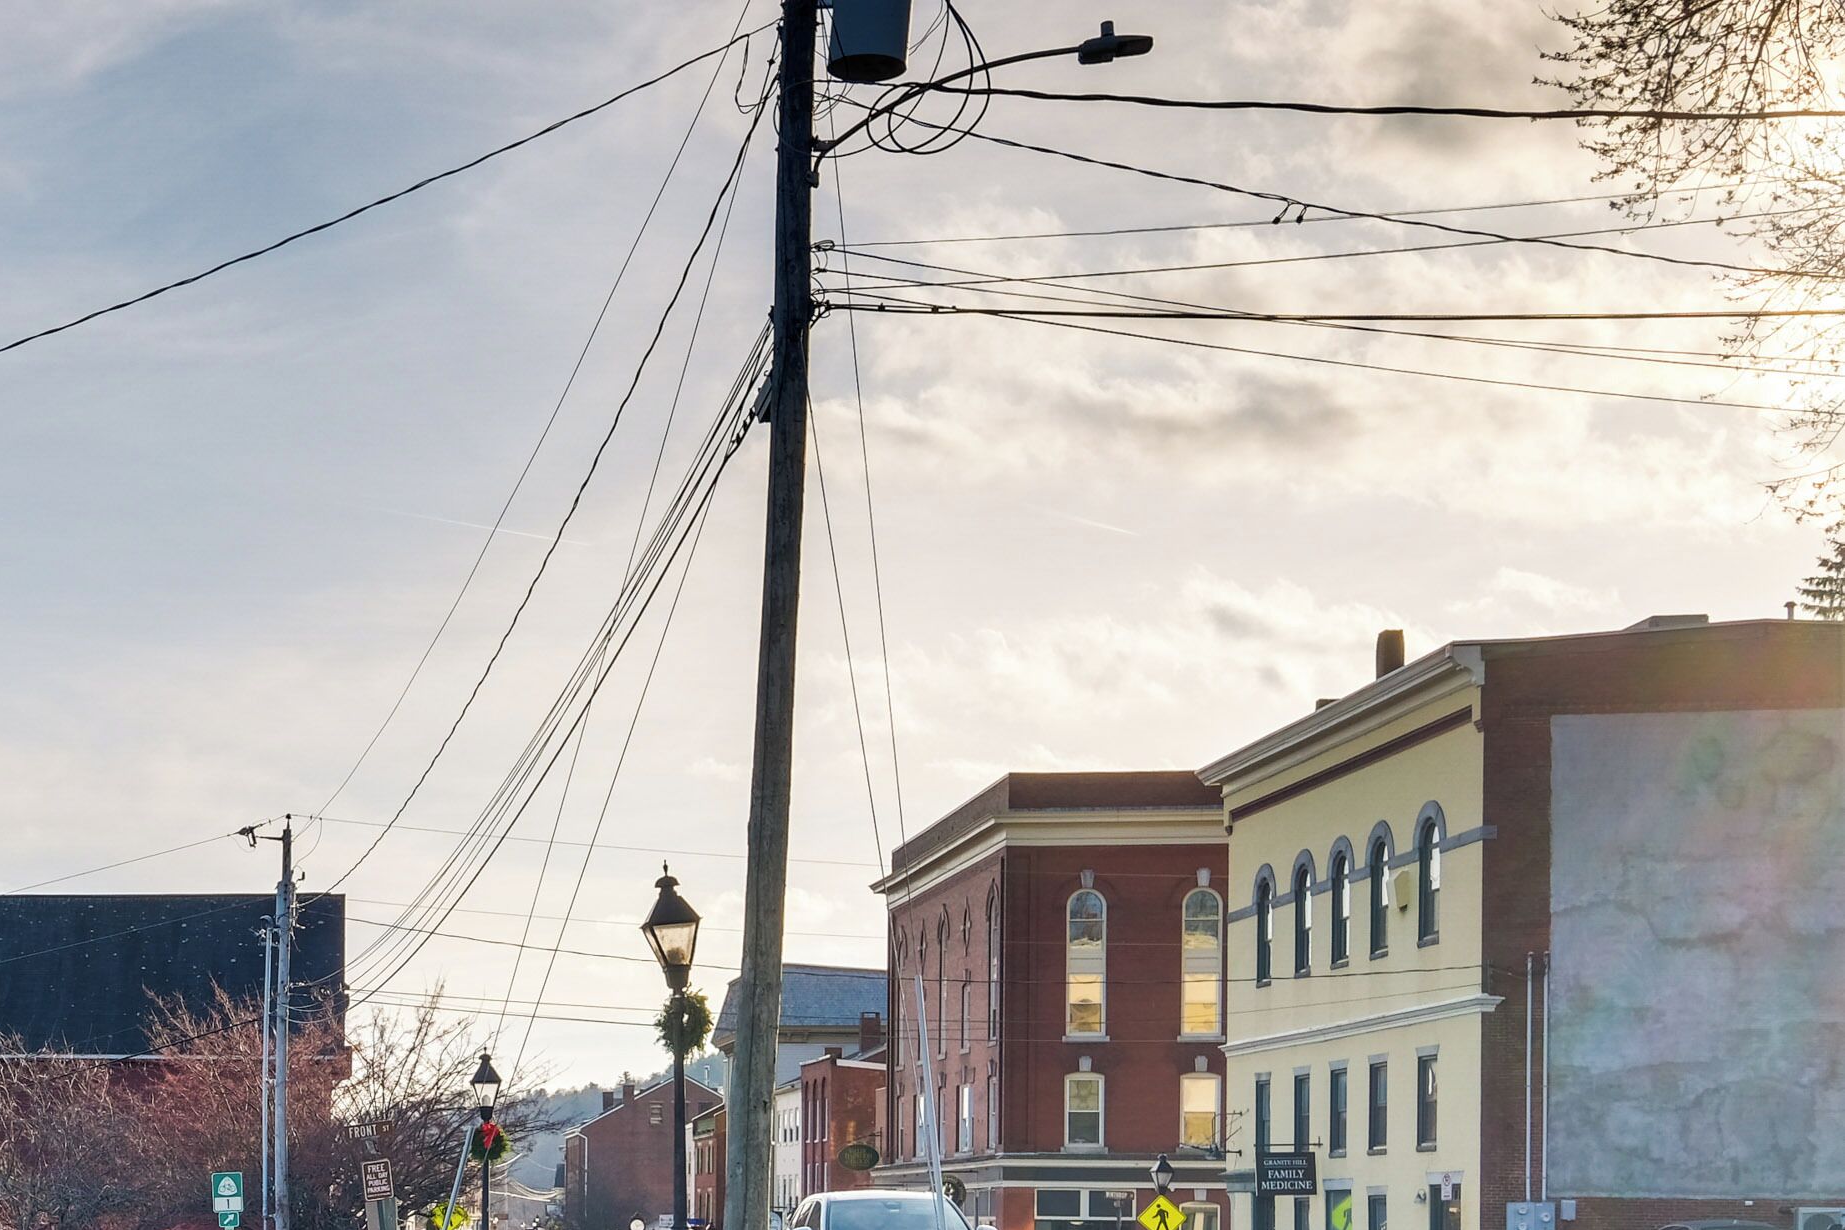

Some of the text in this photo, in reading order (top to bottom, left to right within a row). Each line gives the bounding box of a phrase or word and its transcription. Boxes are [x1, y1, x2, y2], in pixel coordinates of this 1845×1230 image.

[348, 1124, 390, 1139] FRONT ST
[367, 1163, 386, 1173] FREE
[1267, 1169, 1305, 1179] FAMILY
[368, 1178, 388, 1187] PUBLIC
[1261, 1180, 1313, 1190] MEDICINE
[367, 1184, 391, 1194] PARKING
